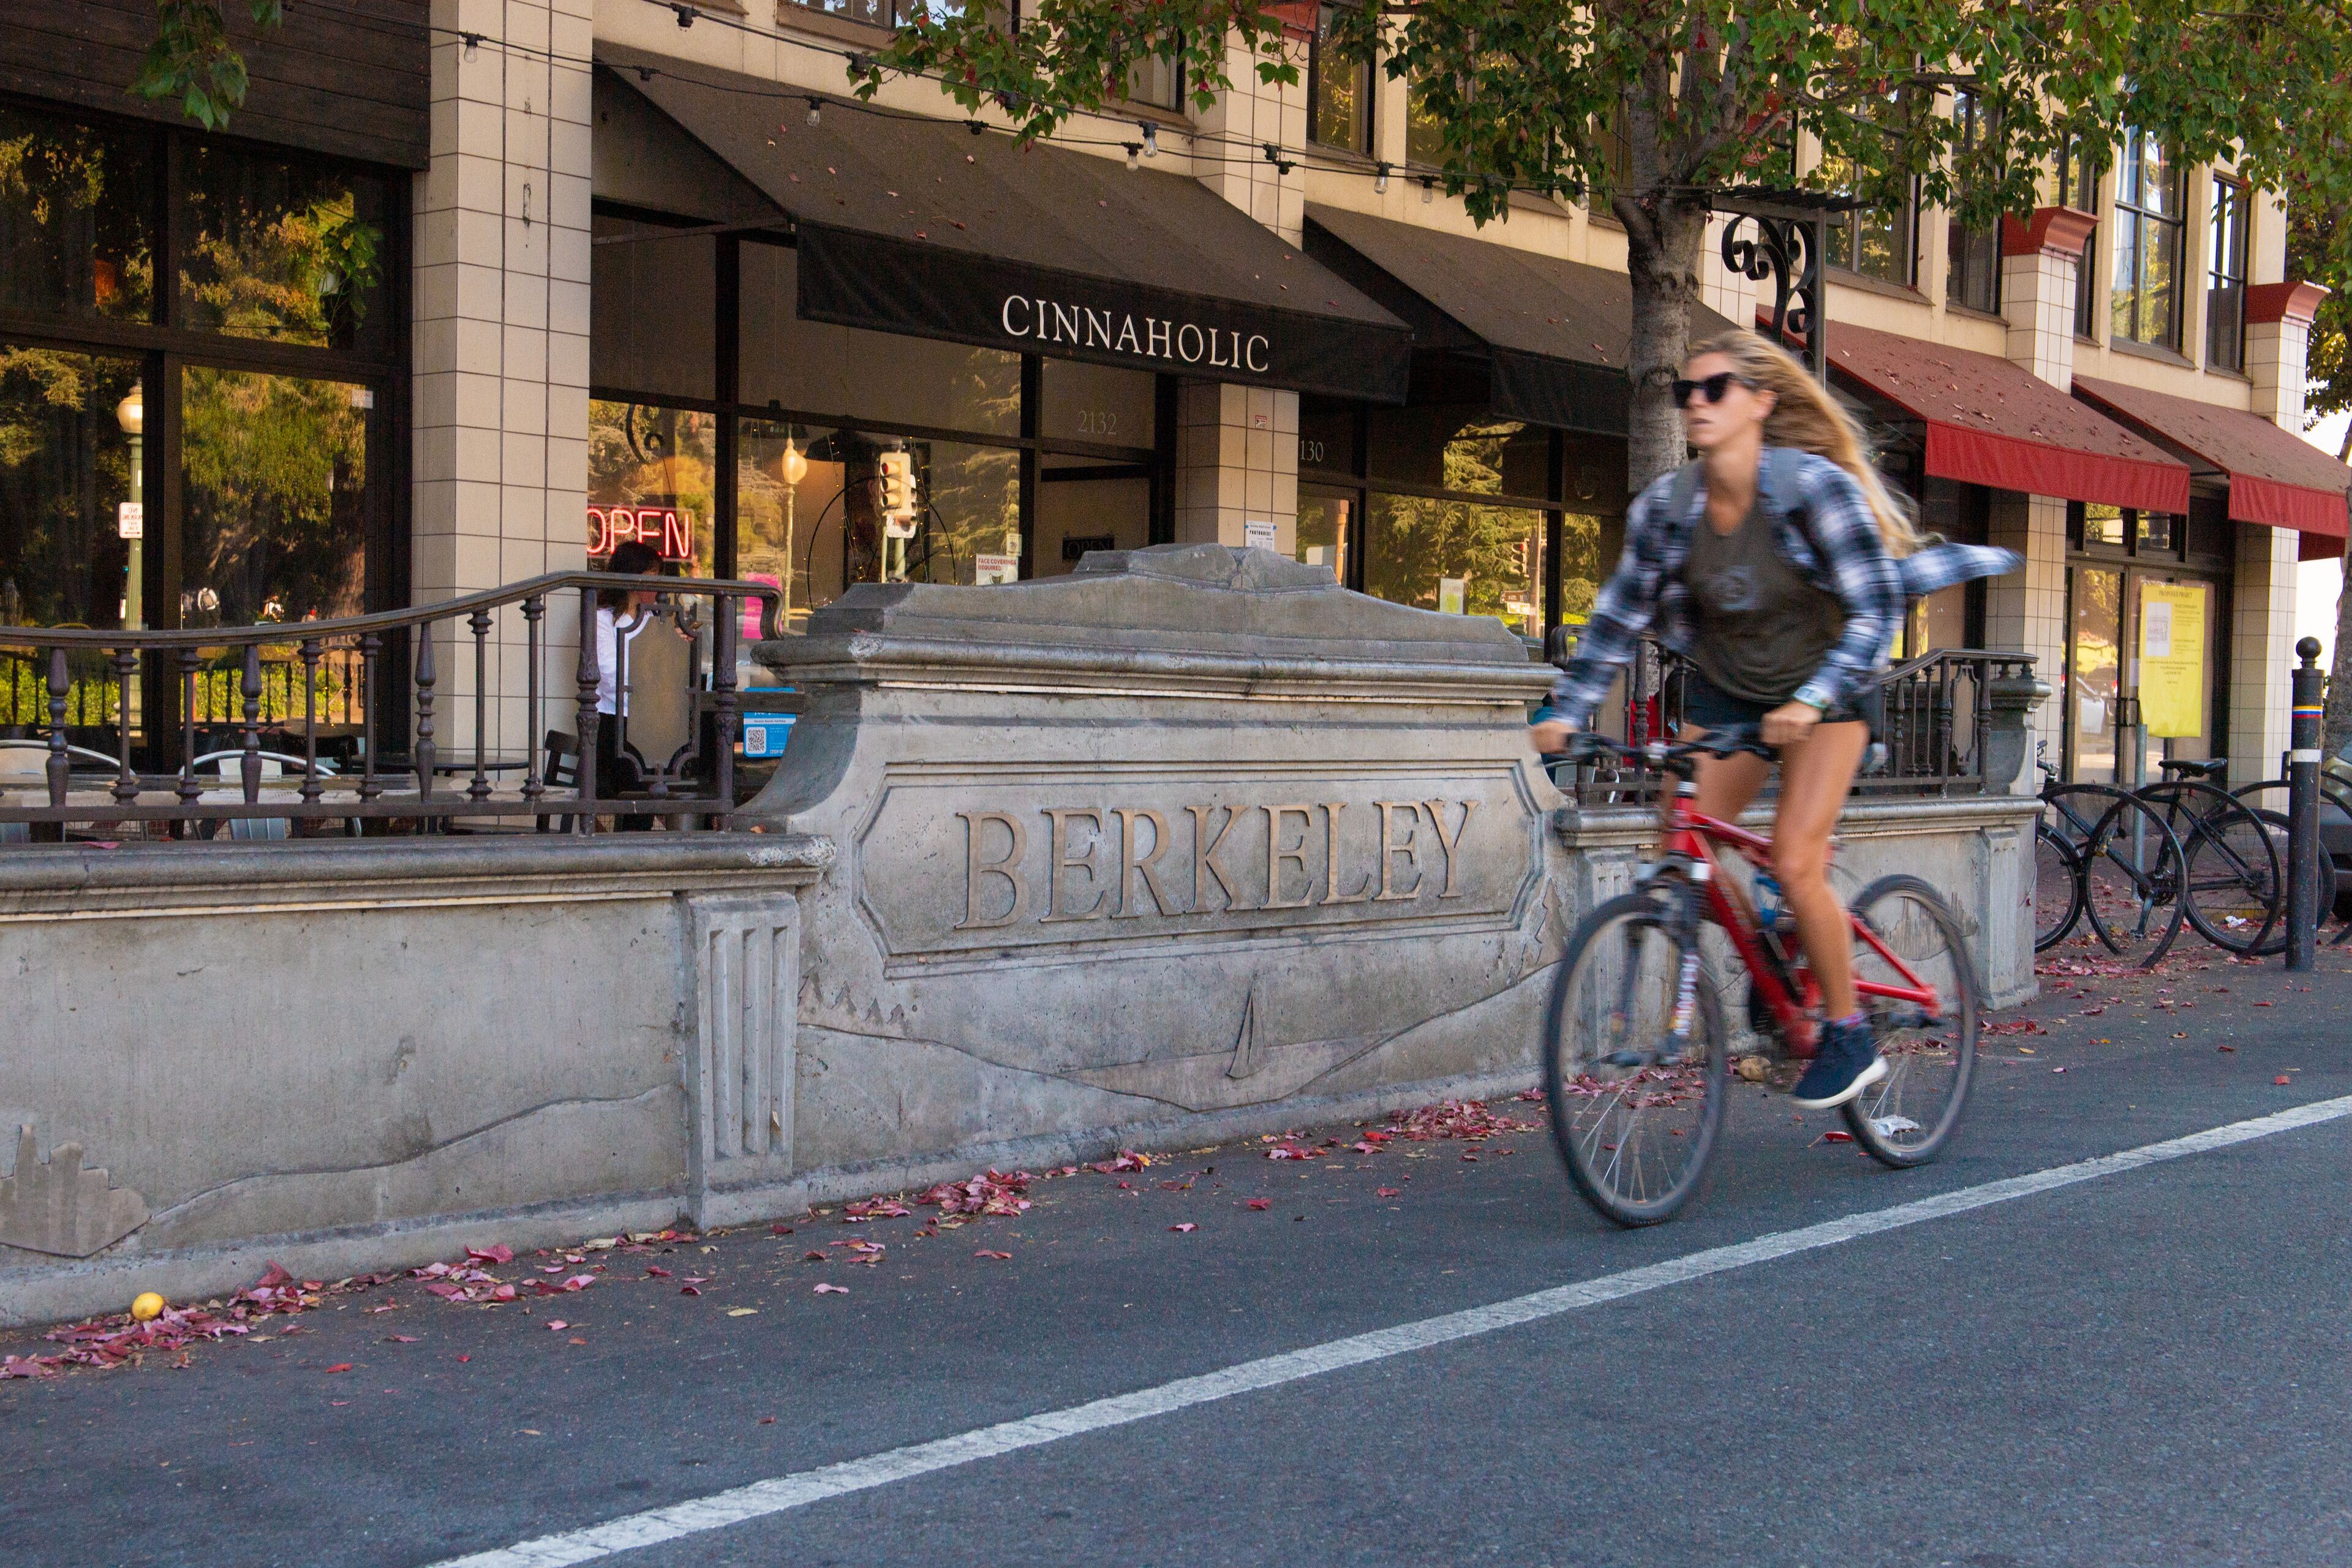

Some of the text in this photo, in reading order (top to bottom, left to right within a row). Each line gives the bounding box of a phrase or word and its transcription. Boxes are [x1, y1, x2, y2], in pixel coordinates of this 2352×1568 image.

[1003, 295, 1268, 372] CINNAHOLIC
[1078, 410, 1117, 435] 2132
[587, 508, 690, 558] OPEN
[954, 799, 1480, 929] BERKELEY
